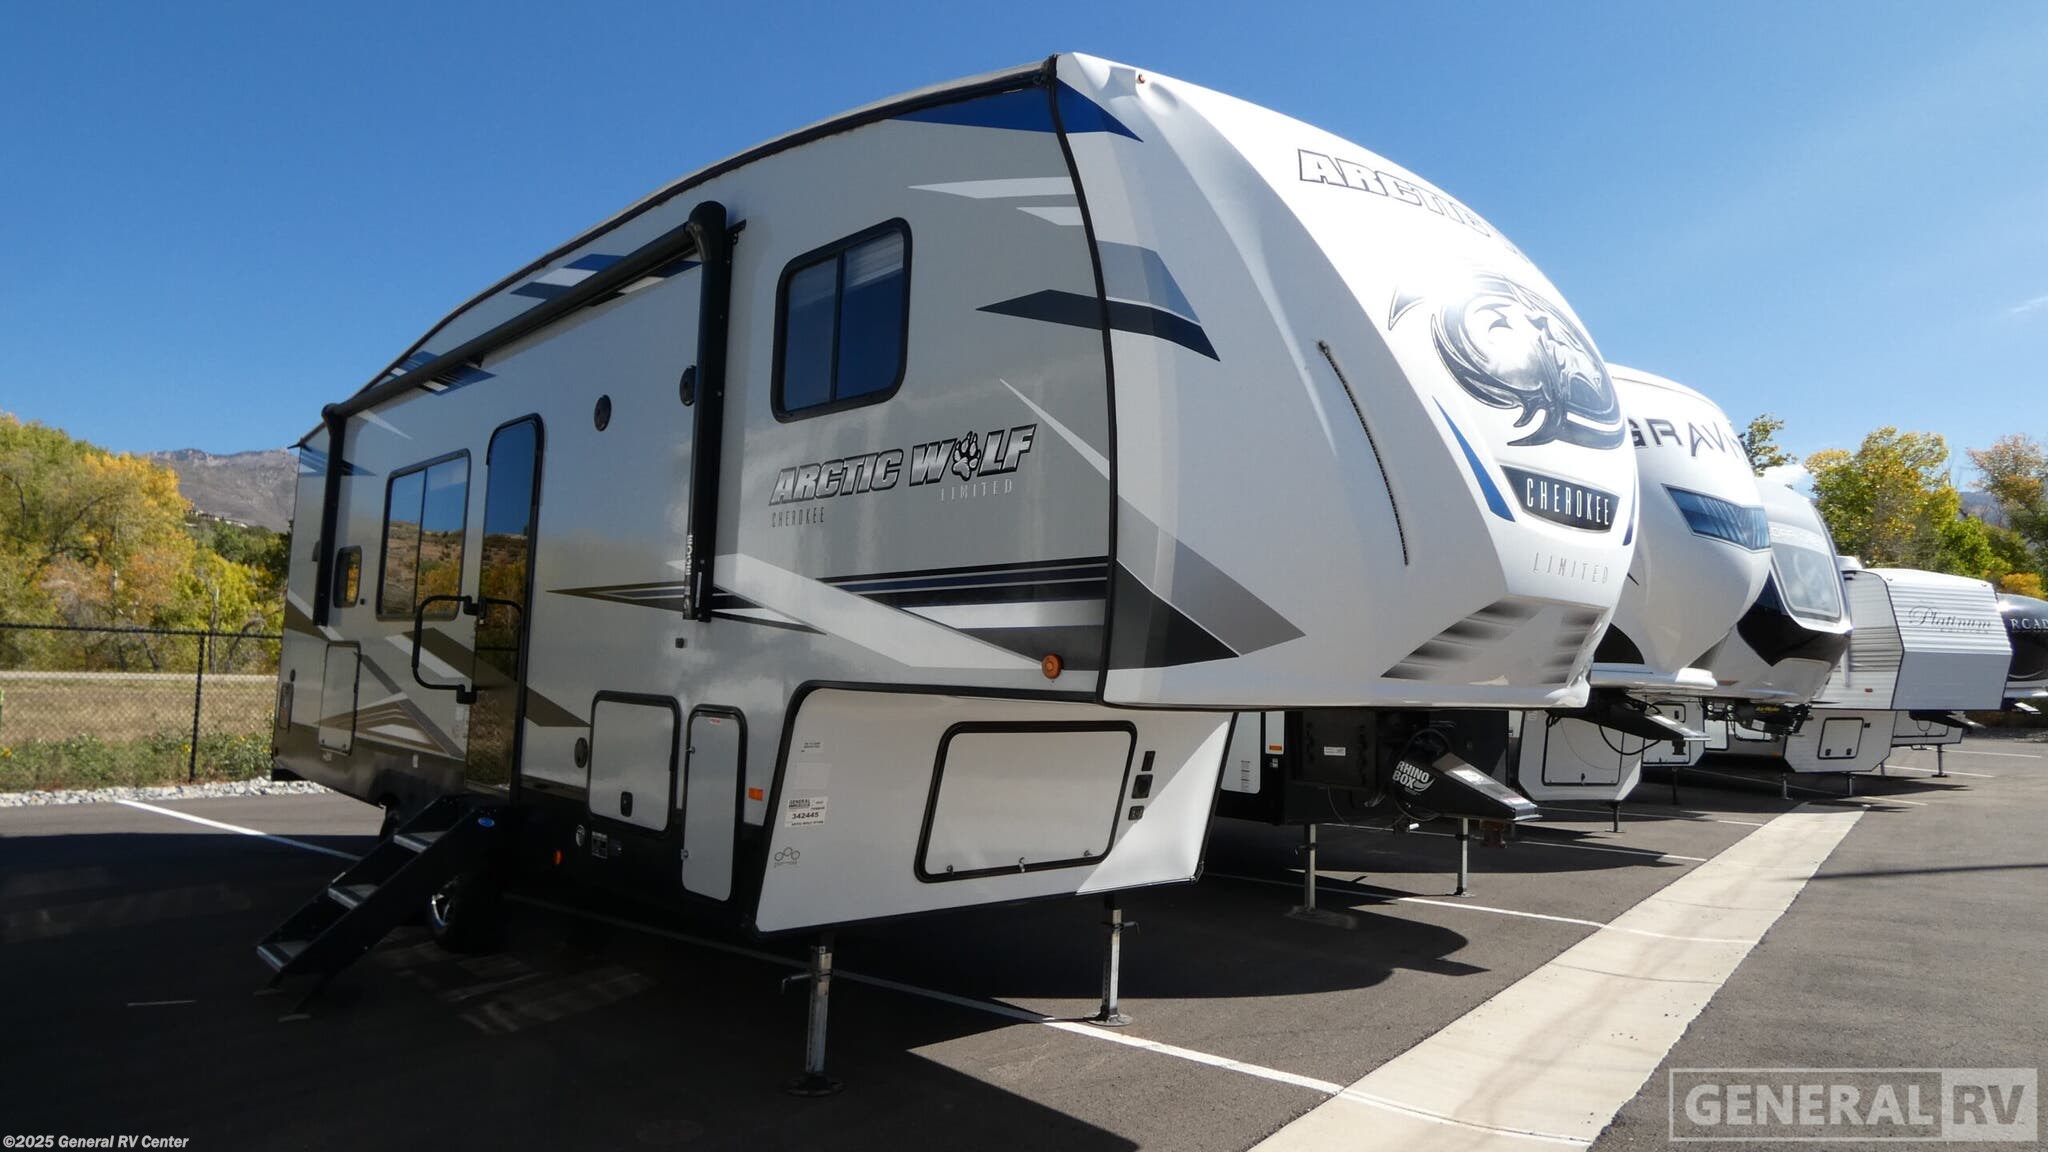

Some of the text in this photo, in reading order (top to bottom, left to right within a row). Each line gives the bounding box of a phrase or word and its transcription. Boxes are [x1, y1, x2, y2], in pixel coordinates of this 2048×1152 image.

[769, 448, 904, 506] ARCTIC
[940, 478, 1014, 502] LIMITED
[1526, 477, 1610, 526] CHEROKEE
[771, 506, 826, 529] CHEROKEE
[1532, 551, 1610, 585] LIMITED
[1907, 604, 1993, 630] Platinum
[1392, 770, 1416, 789] BOX
[1396, 760, 1430, 783] RHINO
[791, 811, 820, 820] 342445
